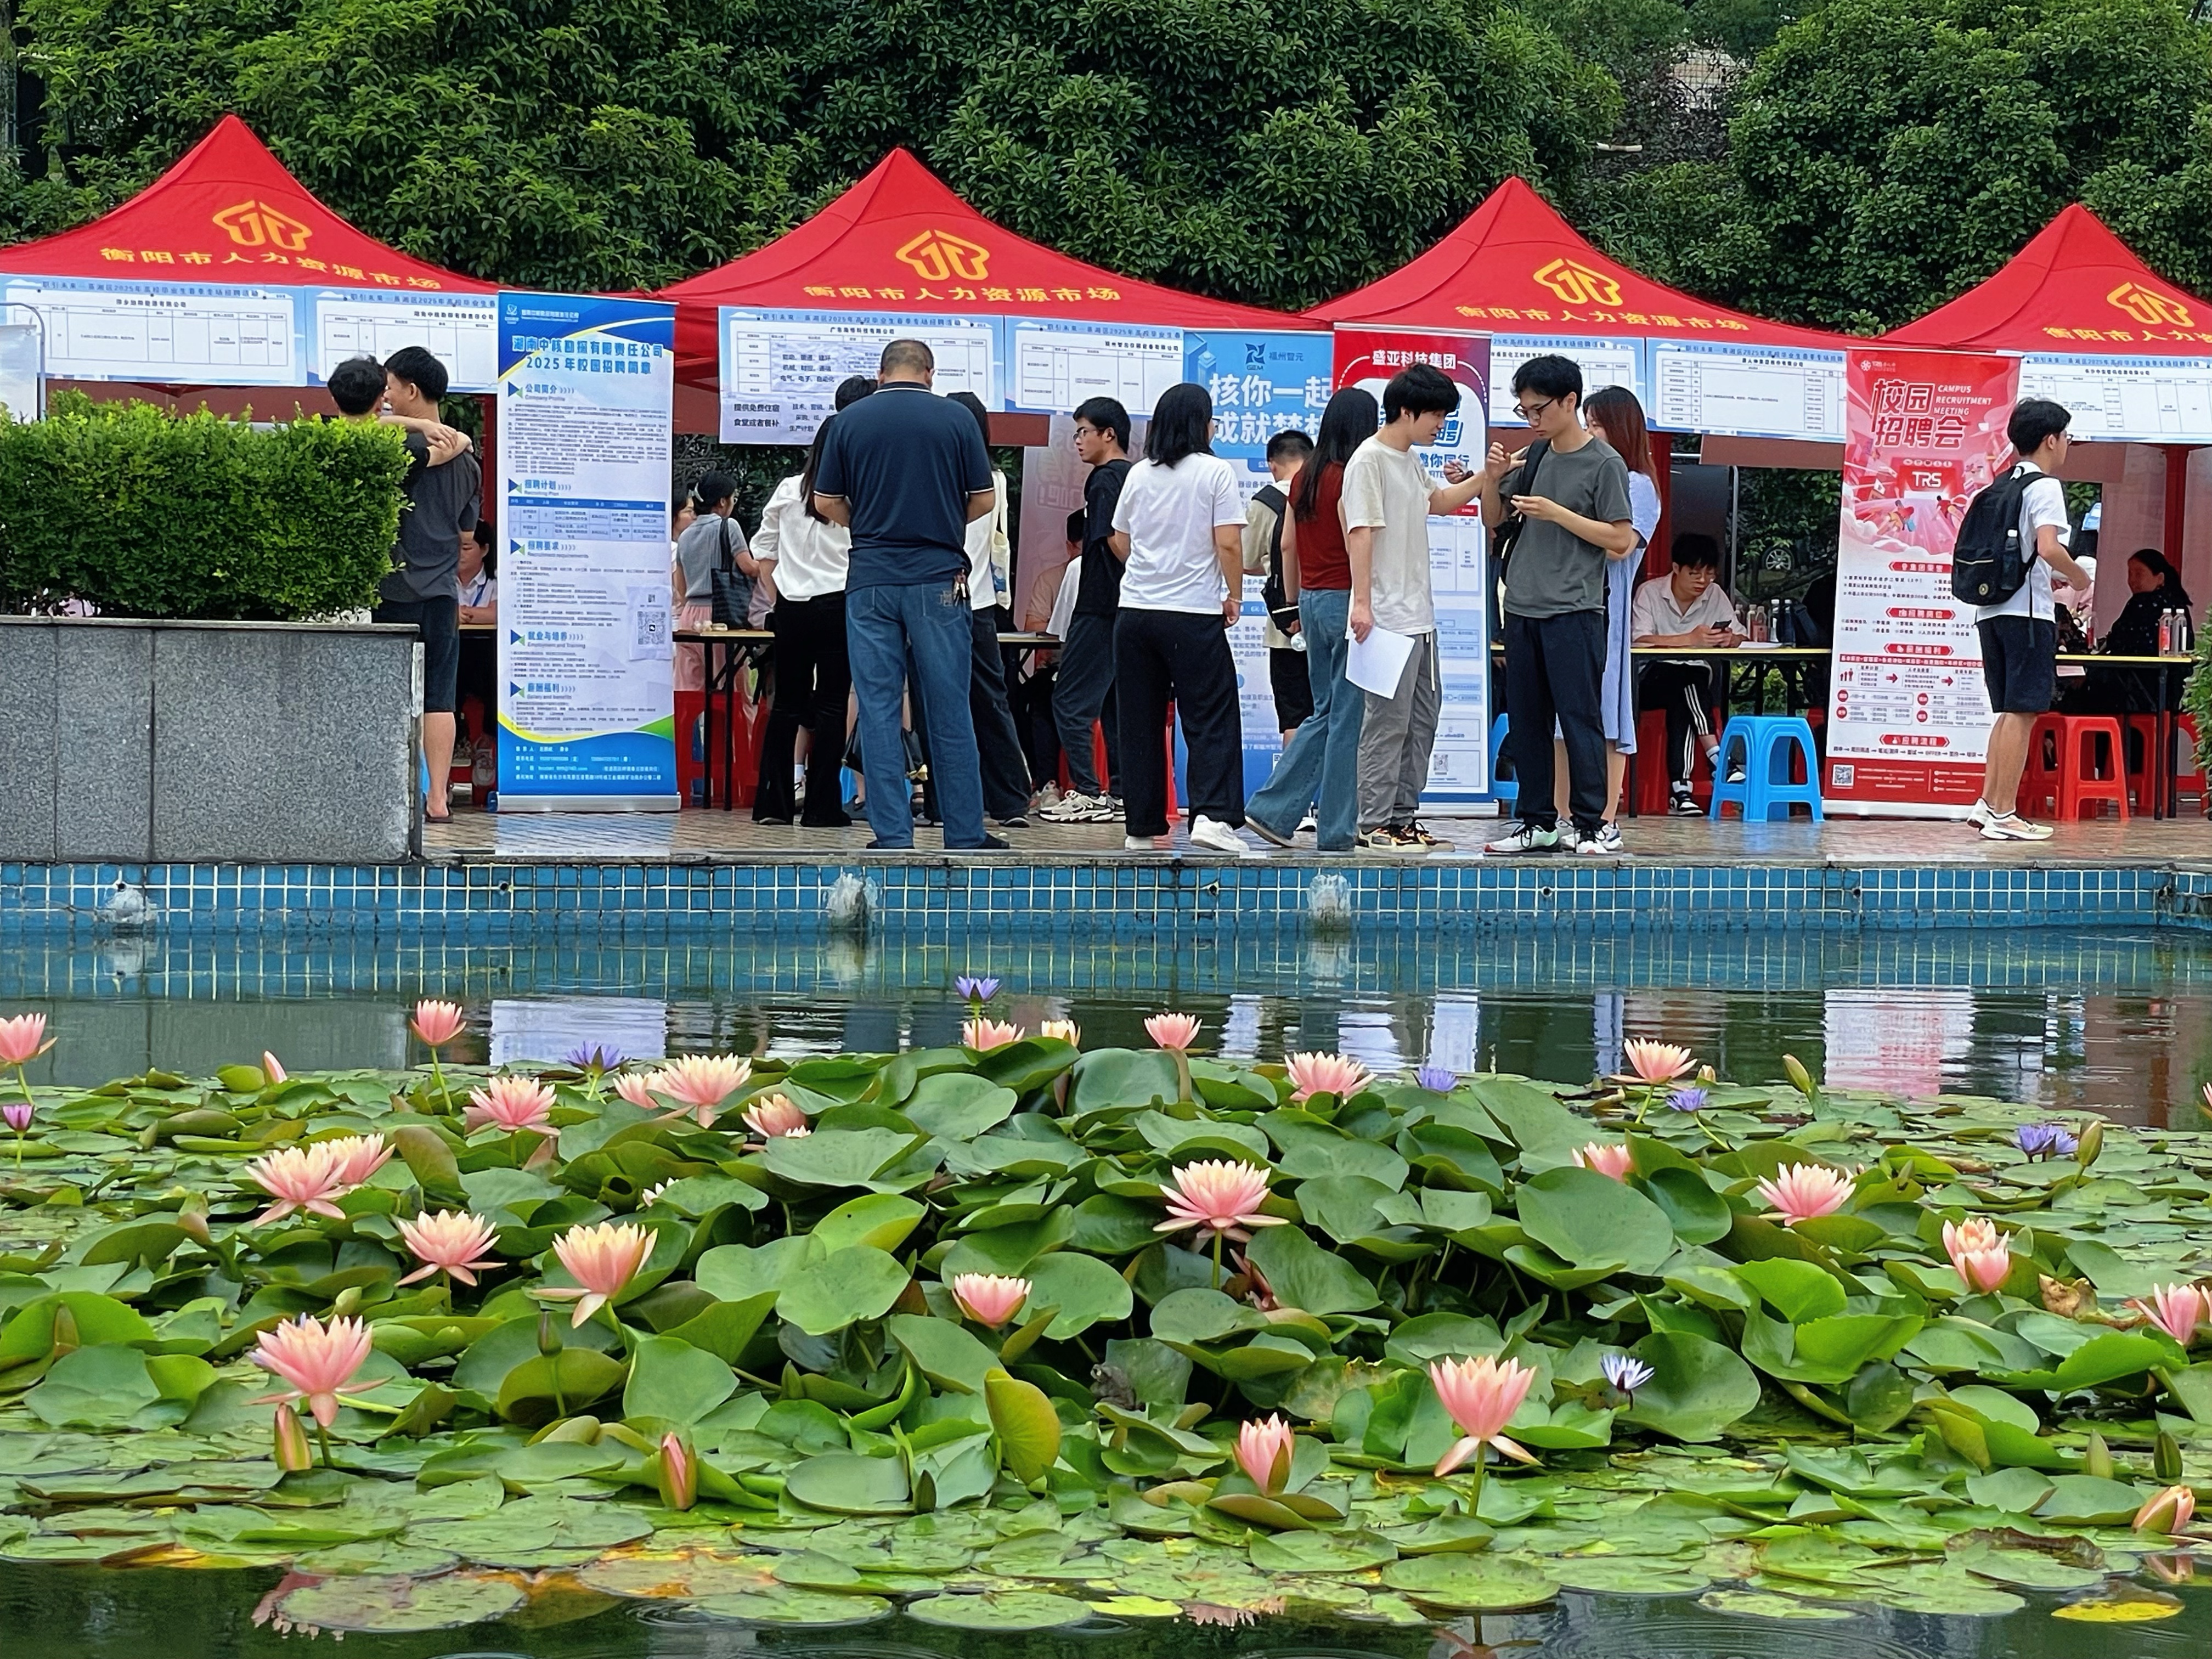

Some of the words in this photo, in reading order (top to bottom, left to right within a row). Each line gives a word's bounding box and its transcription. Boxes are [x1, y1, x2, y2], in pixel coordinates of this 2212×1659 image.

[100, 246, 442, 291] 衡阳市人力资源市场
[803, 286, 1121, 302] 衡阳市人力资源市场
[1454, 305, 1750, 331] 衡阳市人力资源市场
[512, 335, 664, 358] 湖南中核勘探有限责任公司
[1269, 352, 1304, 362] 福州智元
[1372, 349, 1456, 370] 盛亚科技集团
[525, 383, 557, 394] 公司简介
[1209, 373, 1334, 408] 核你一起
[1938, 385, 1972, 393] CAMPUS
[734, 403, 780, 413] 提供免费住宿
[1870, 378, 1935, 431] 校园
[1936, 396, 1992, 405] RECRUITMENT
[1874, 415, 1970, 450] 招聘会
[1912, 471, 1942, 487] TRS
